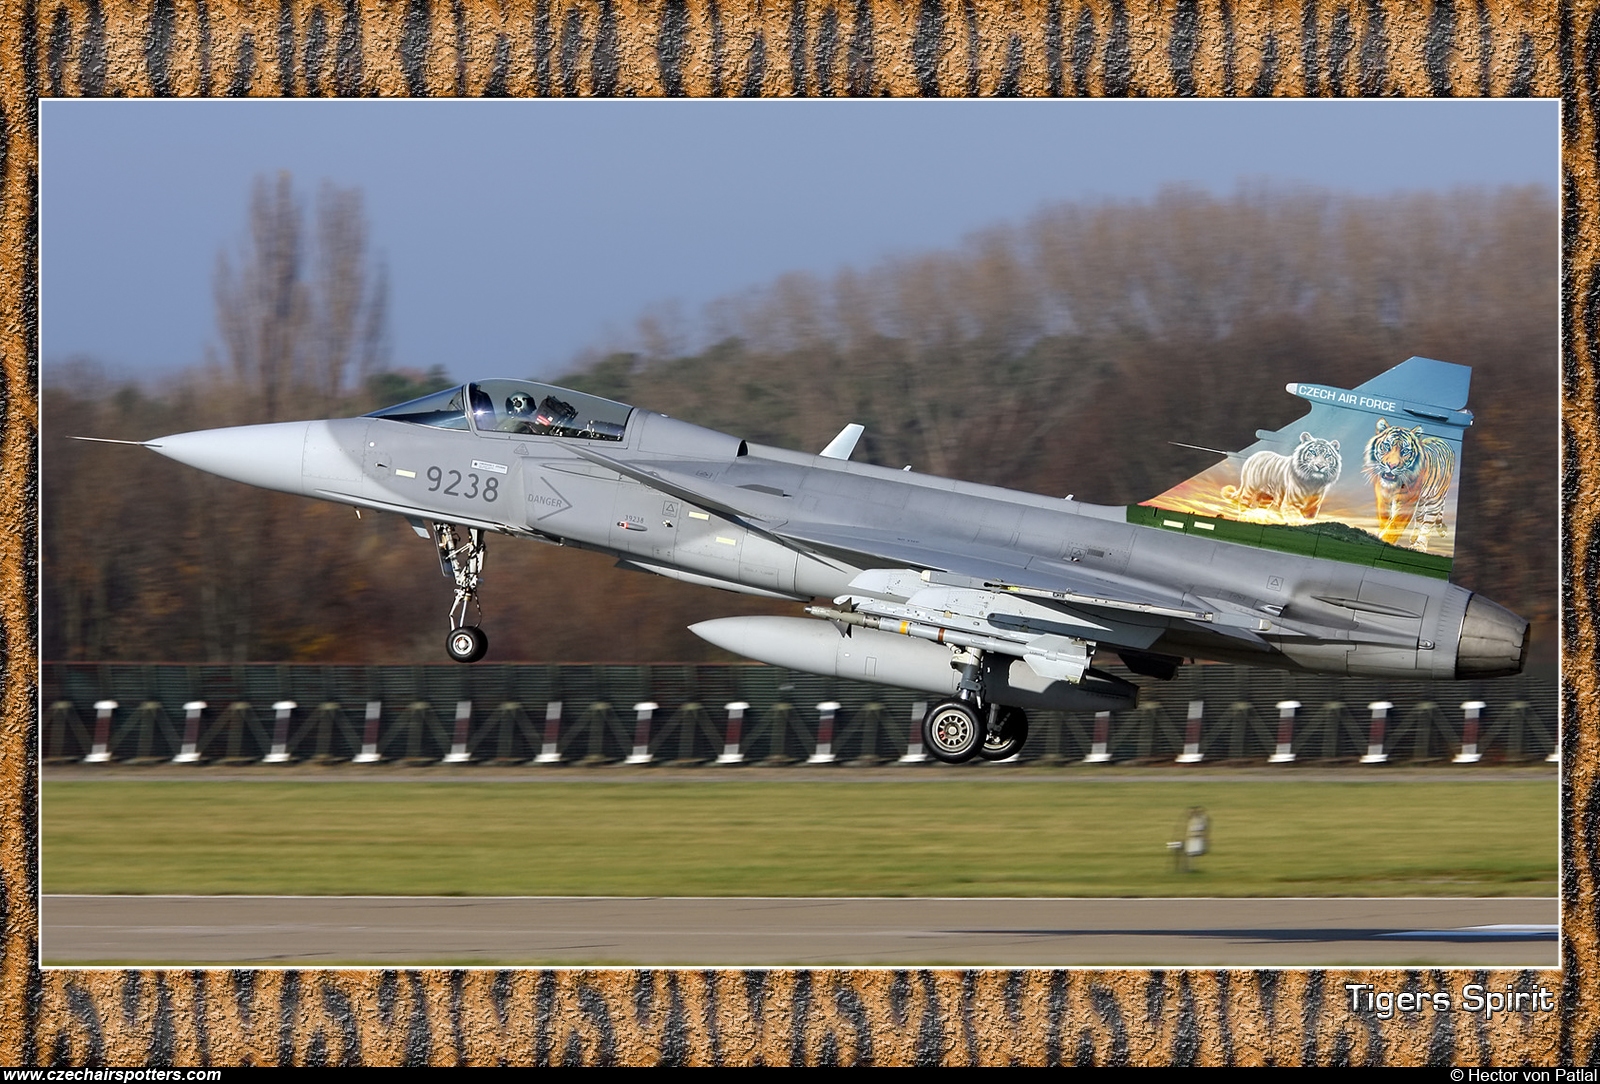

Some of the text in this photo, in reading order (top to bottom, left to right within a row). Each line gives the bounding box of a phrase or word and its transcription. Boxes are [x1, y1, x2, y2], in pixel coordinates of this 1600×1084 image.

[1298, 385, 1396, 412] CZECH AIR FORCE
[426, 465, 500, 503] 9238
[527, 493, 563, 508] DANGER
[624, 514, 645, 524] 39238
